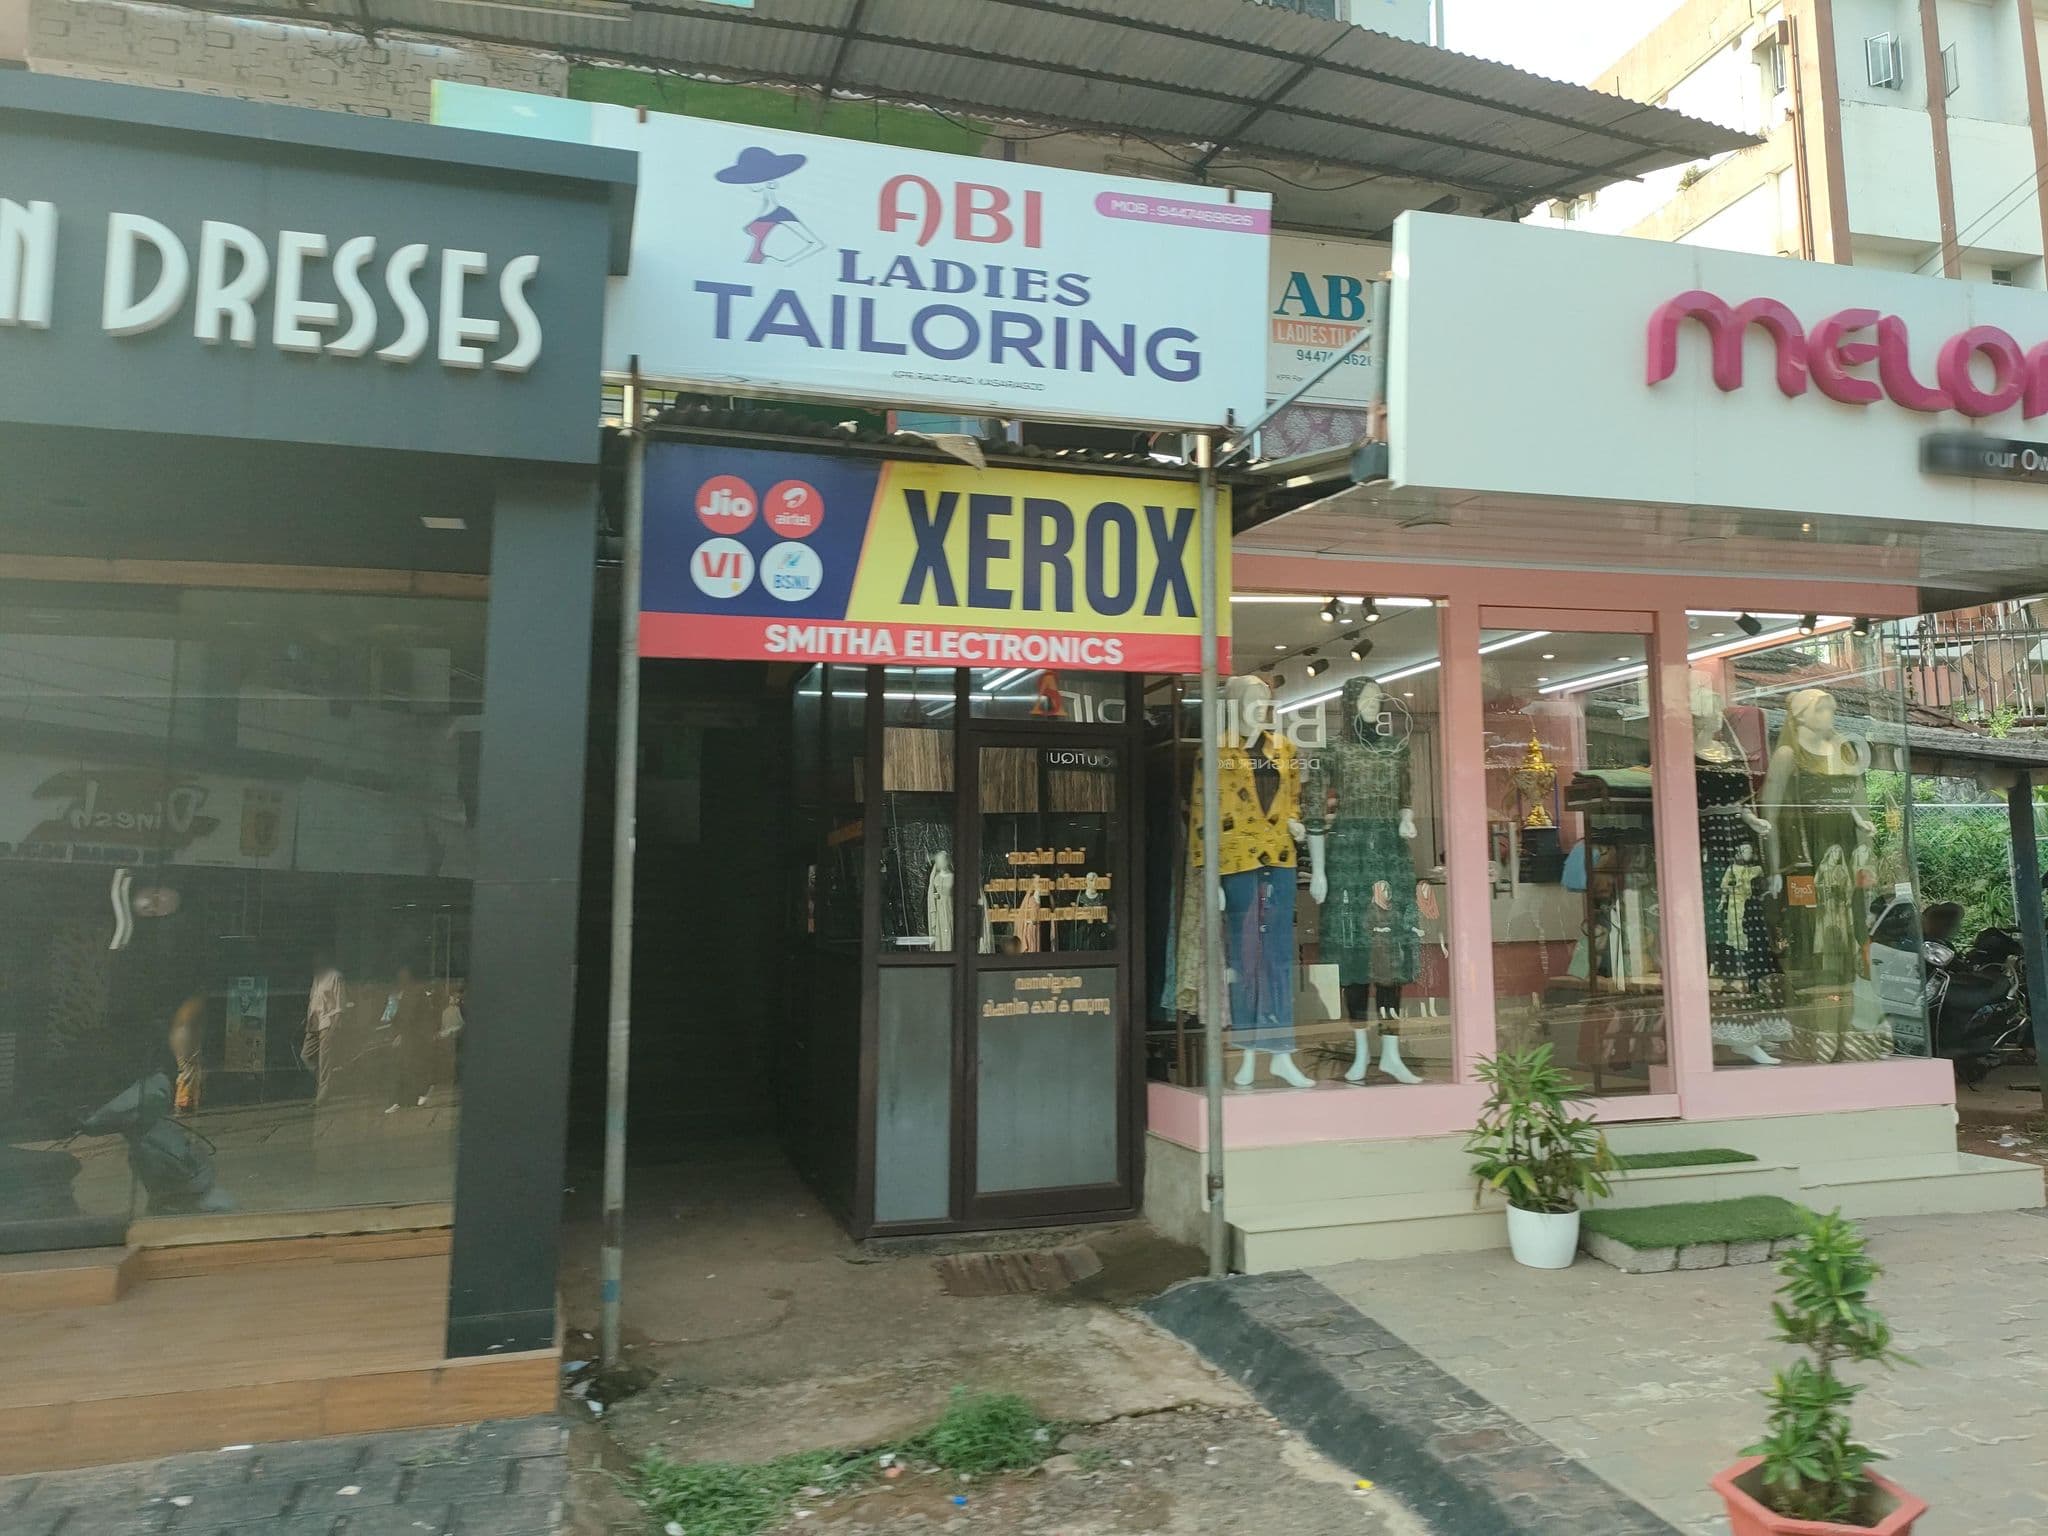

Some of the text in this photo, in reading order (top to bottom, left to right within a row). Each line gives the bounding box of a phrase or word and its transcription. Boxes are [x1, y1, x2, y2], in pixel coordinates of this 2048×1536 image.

[877, 174, 1043, 249] ABI
[103, 212, 543, 373] DRESSES
[837, 249, 1092, 306] LADIES
[694, 280, 1201, 383] TAILORING
[1277, 321, 1328, 345] LADIES
[700, 488, 752, 517] Jio
[775, 512, 812, 526] airtel
[900, 488, 1199, 619] XEROX
[764, 623, 1124, 666] SMITHA ELECTRONICS
